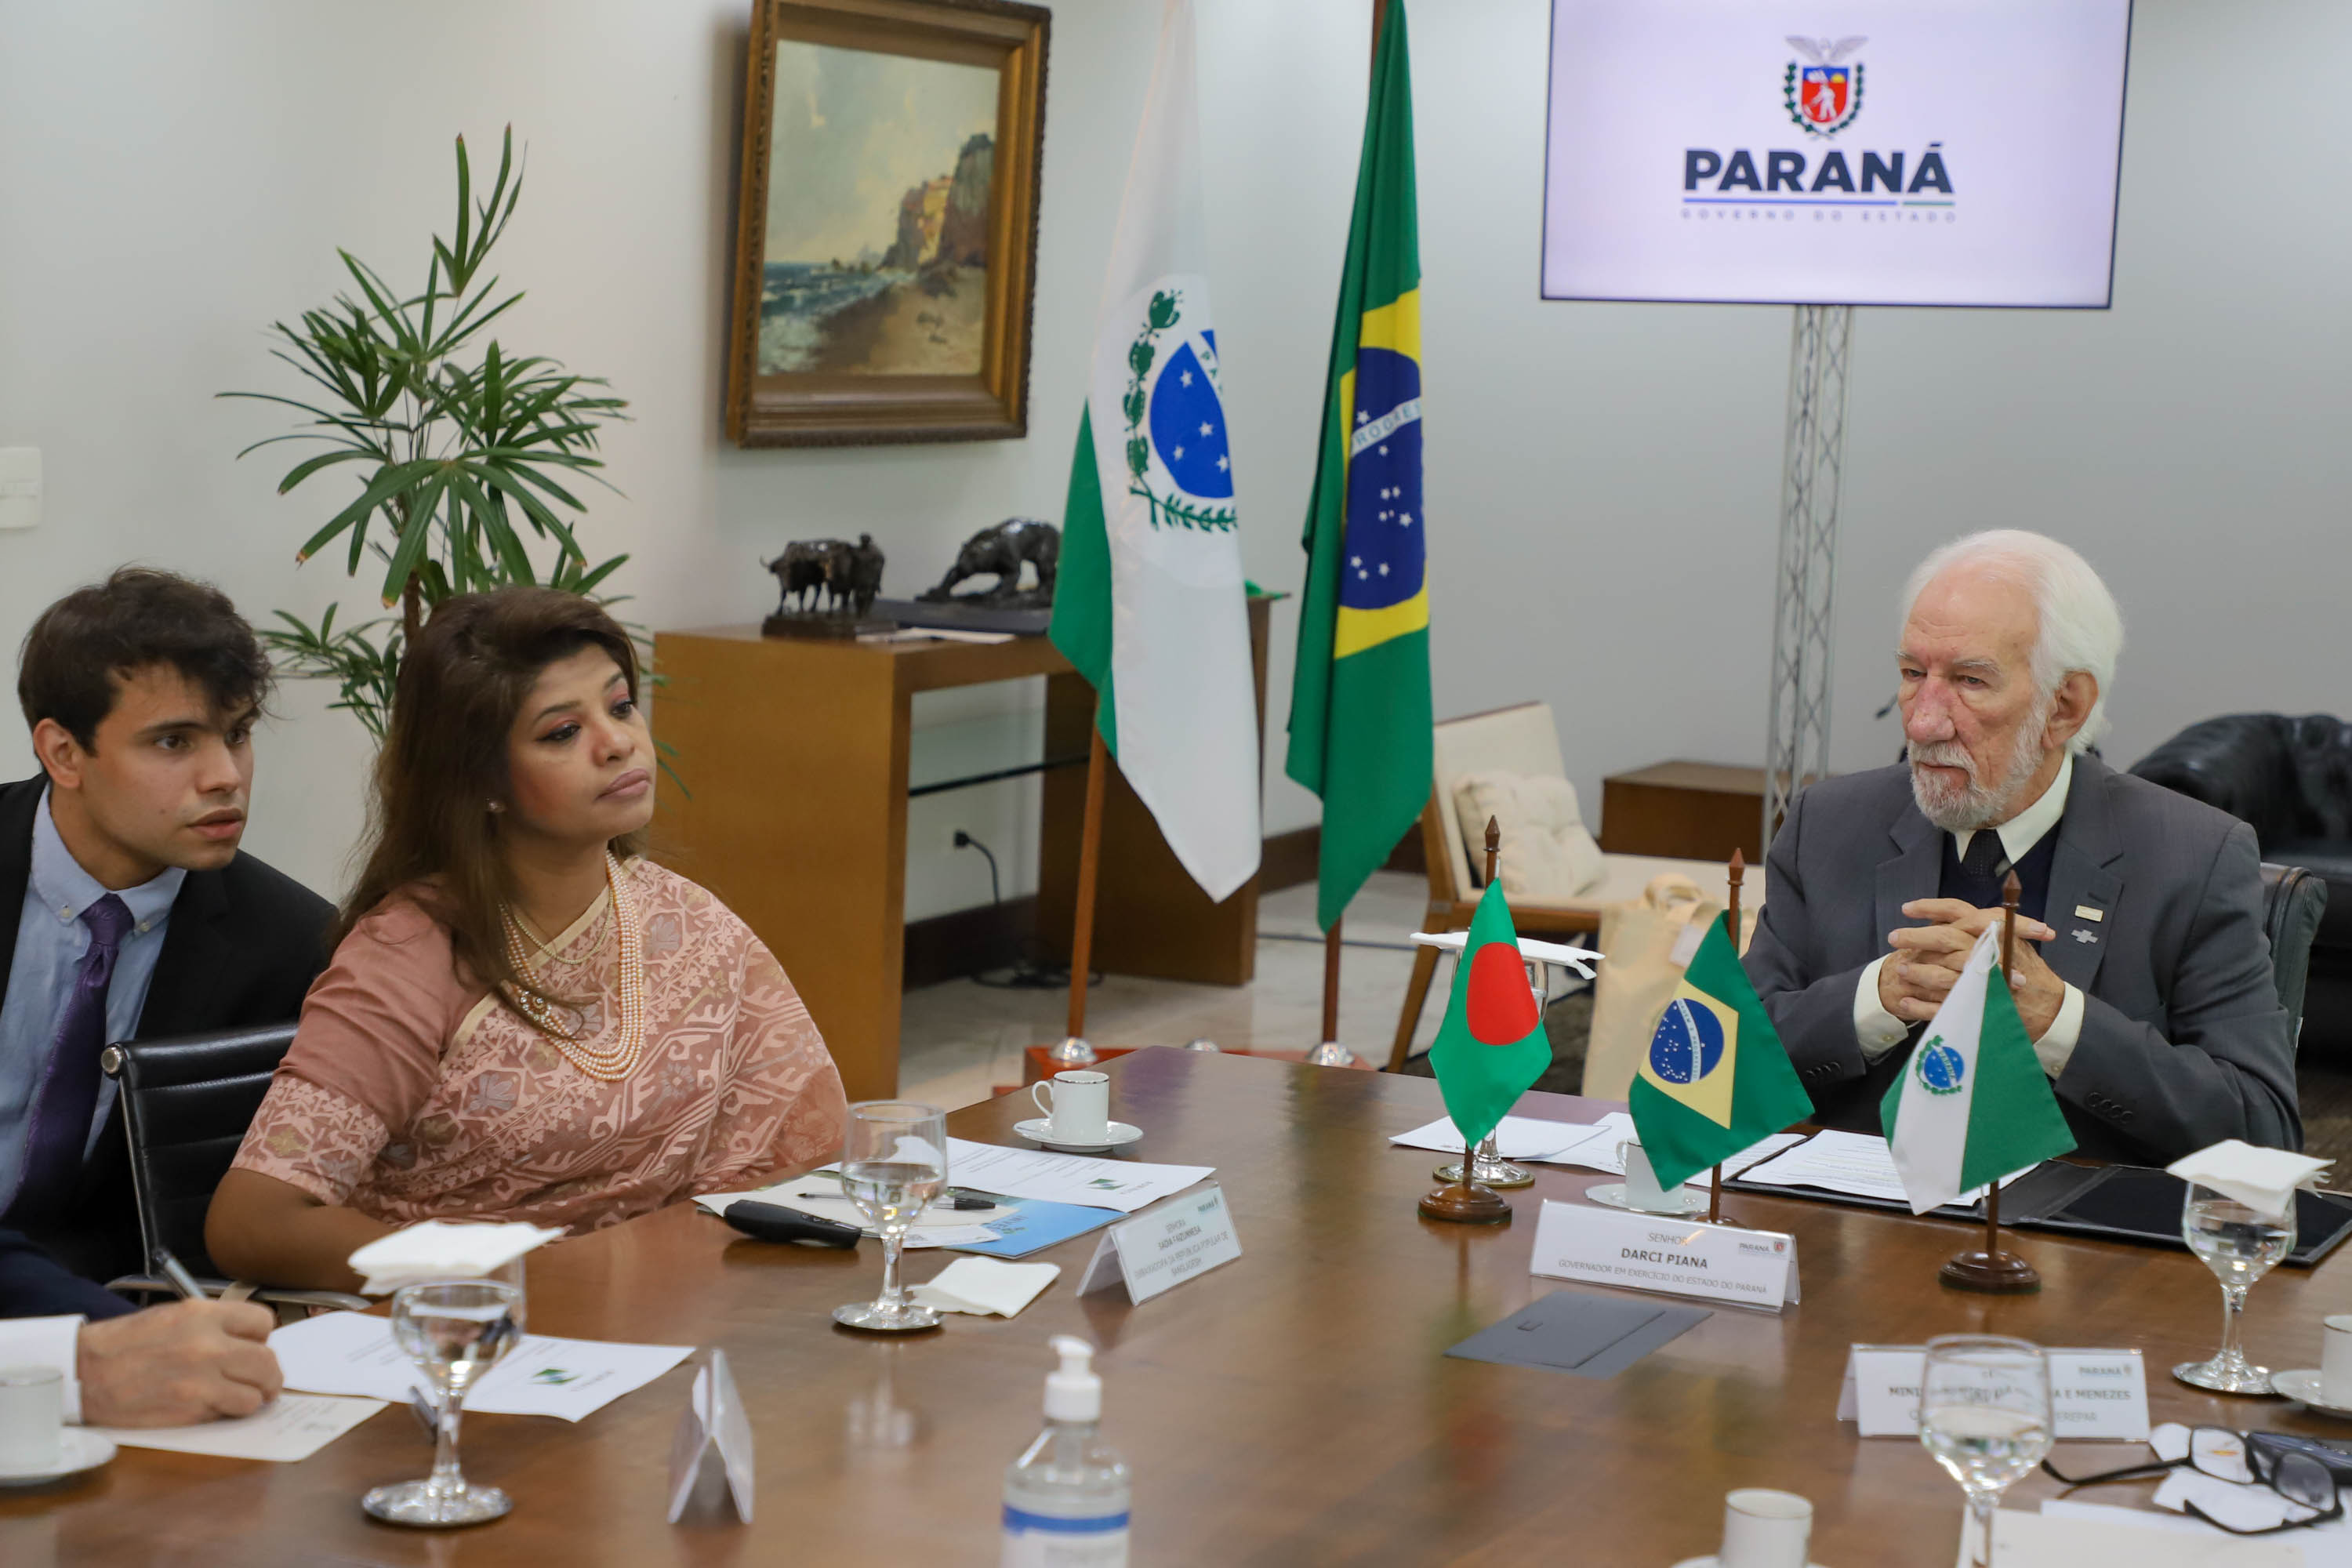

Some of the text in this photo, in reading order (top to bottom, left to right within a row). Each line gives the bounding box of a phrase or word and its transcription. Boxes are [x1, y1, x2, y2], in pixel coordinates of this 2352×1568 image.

[1684, 143, 1955, 194] PARANÁ
[1682, 209, 1956, 223] GOVERNO DO ESTADO
[1621, 1247, 1708, 1269] DARCI PIANA
[1559, 1259, 1613, 1273] GOVERNADOR
[1614, 1267, 1627, 1276] EM
[1672, 1274, 1685, 1283] DO
[1686, 1276, 1719, 1287] ESTADO
[1721, 1280, 1733, 1290] DO
[2076, 1389, 2132, 1401] MENEZES
